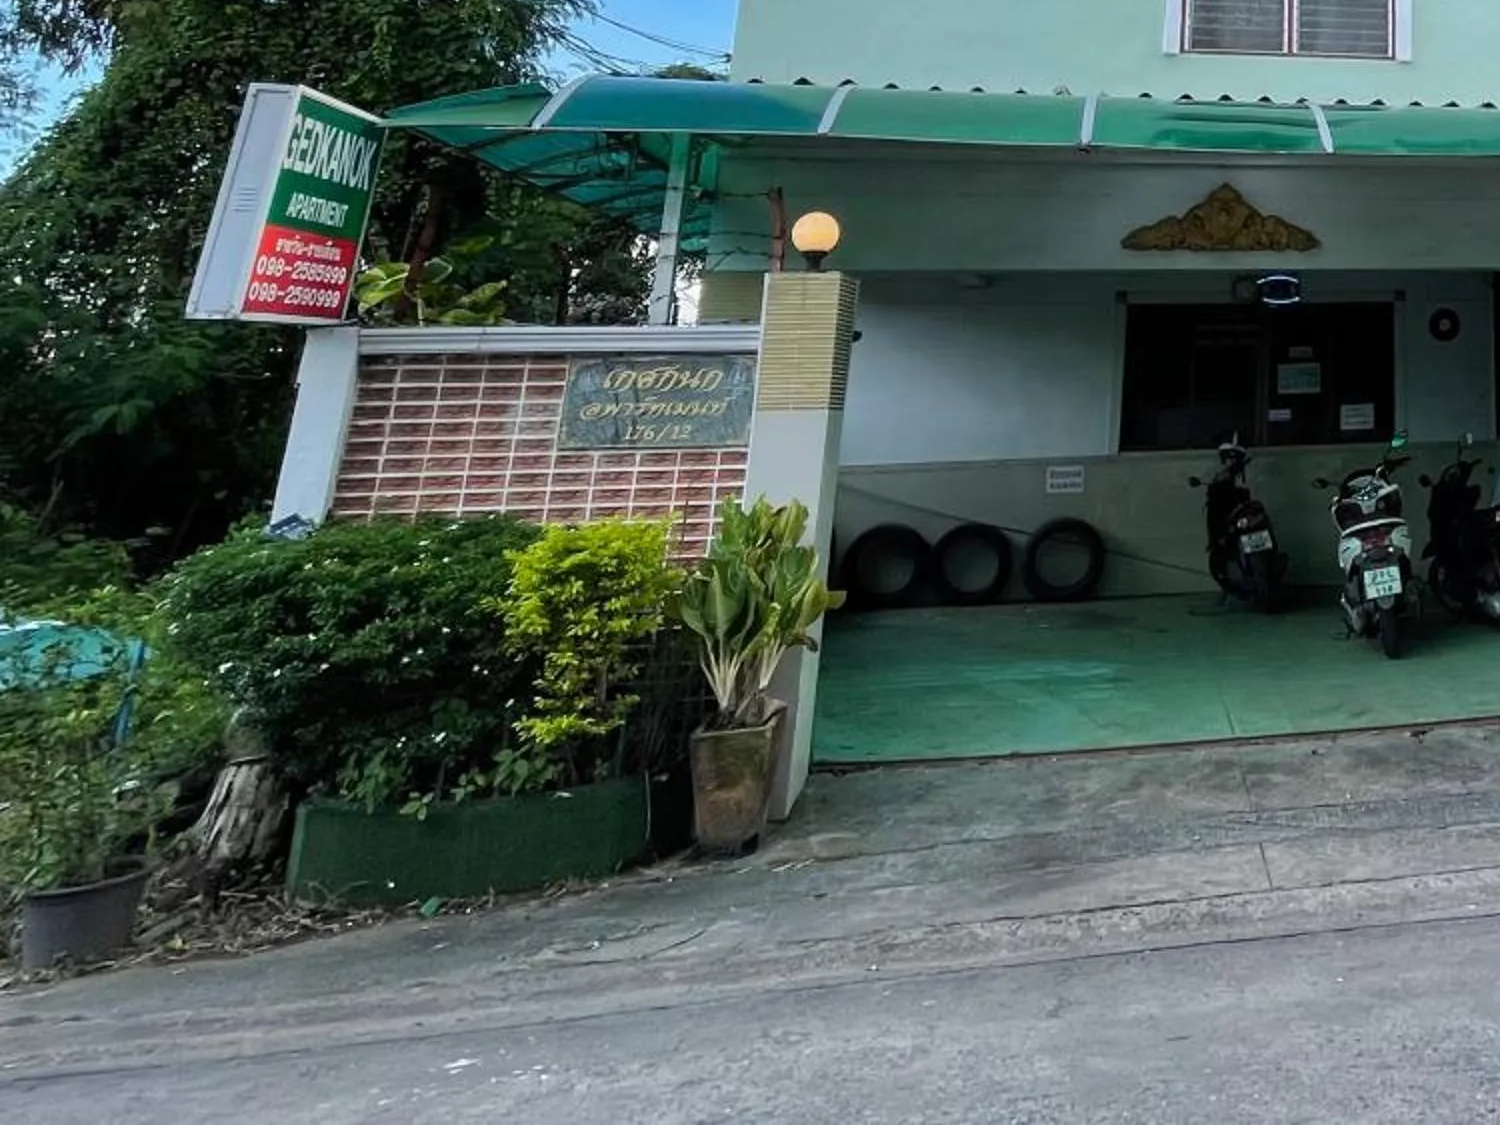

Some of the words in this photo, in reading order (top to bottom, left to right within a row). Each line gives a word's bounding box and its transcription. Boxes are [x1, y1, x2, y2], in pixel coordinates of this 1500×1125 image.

[283, 113, 378, 191] GEDKANOK
[286, 192, 348, 227] APARTMENT
[623, 423, 693, 443] 176/12
